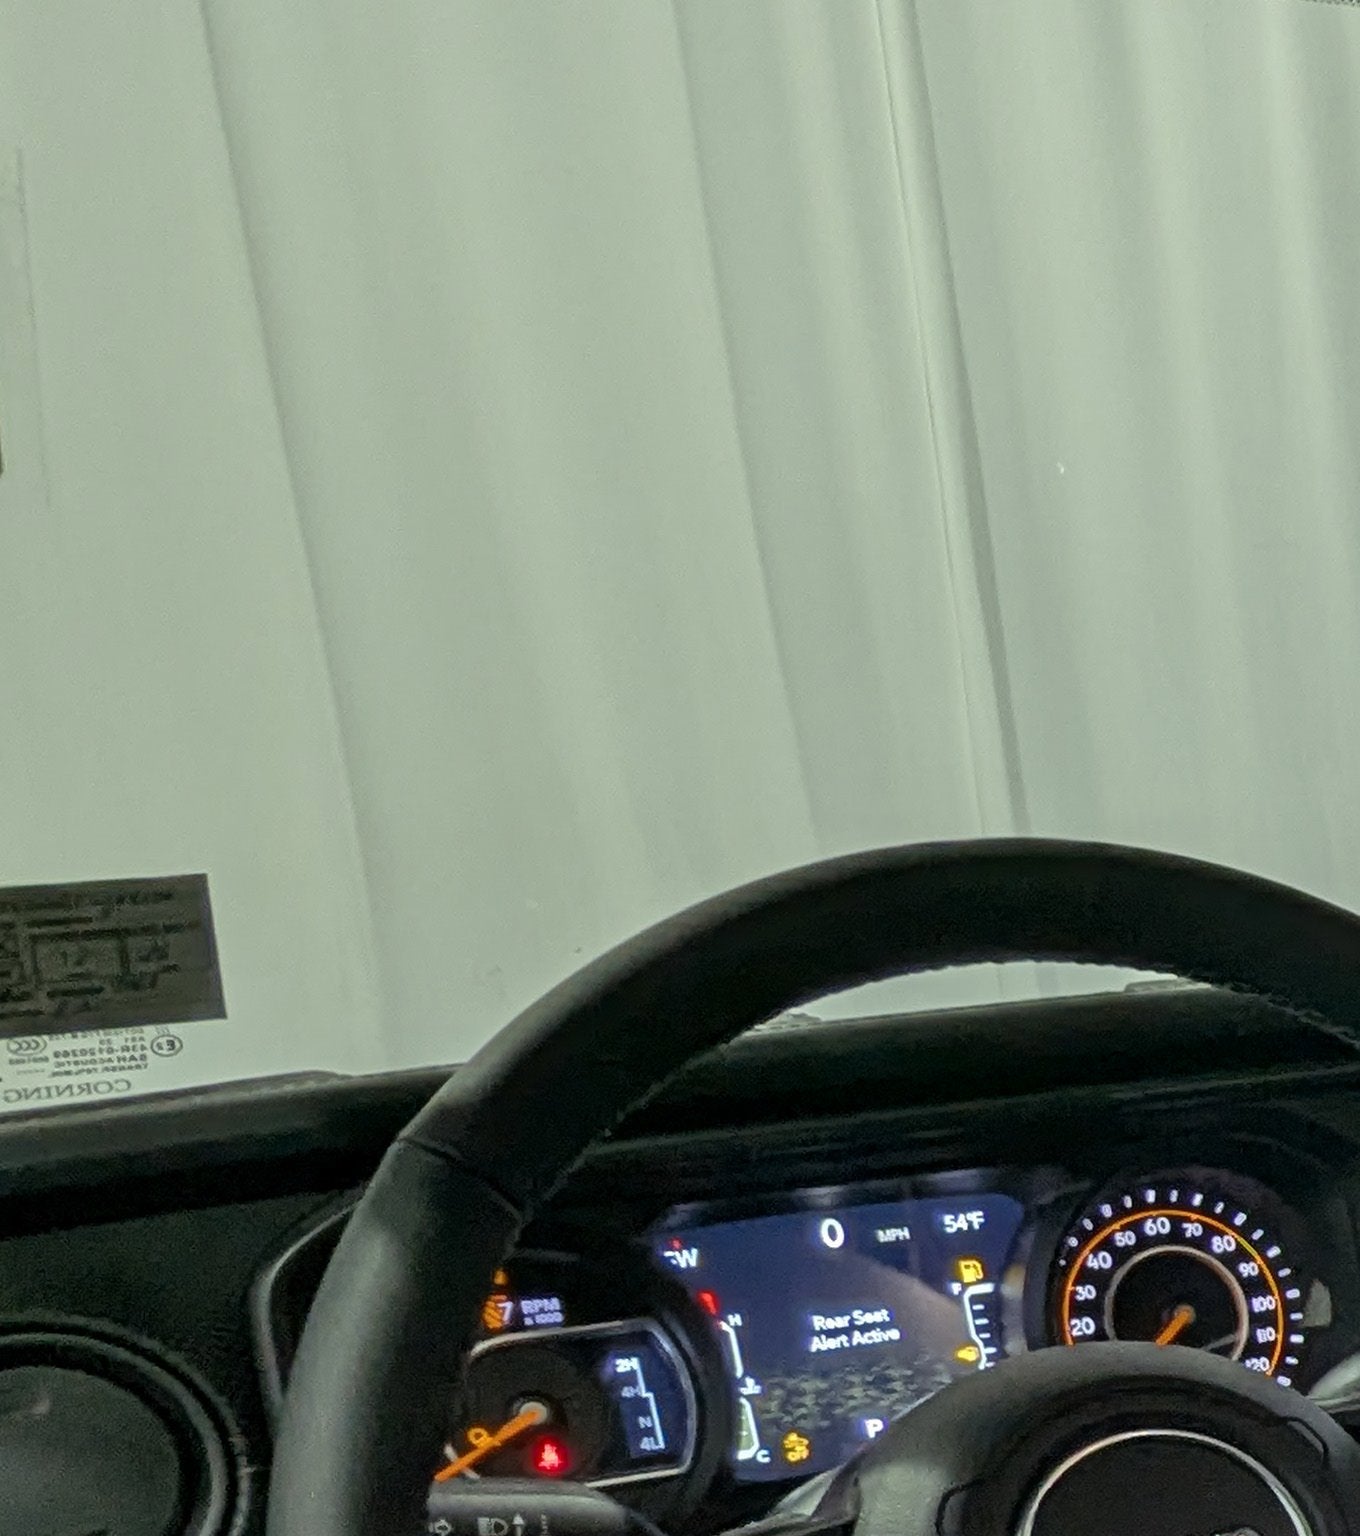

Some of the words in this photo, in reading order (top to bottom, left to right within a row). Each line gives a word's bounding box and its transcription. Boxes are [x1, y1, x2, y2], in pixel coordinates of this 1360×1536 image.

[820, 1217, 845, 1249] 0
[877, 1226, 910, 1243] MPH
[1144, 1217, 1171, 1236] 60
[1181, 1222, 1203, 1238] 70
[1114, 1230, 1137, 1248] 50
[1211, 1235, 1237, 1254] 80
[1087, 1251, 1113, 1270] 40
[1238, 1261, 1260, 1278] 90
[1075, 1284, 1097, 1301] 30
[497, 1300, 513, 1324] 7
[520, 1297, 561, 1314] RPM
[728, 1313, 742, 1327] H
[812, 1312, 851, 1331] Rear
[854, 1307, 891, 1324] Seat
[1070, 1316, 1096, 1337] 20
[810, 1333, 850, 1352] Alert
[852, 1326, 901, 1346] Active
[865, 1418, 885, 1439] P
